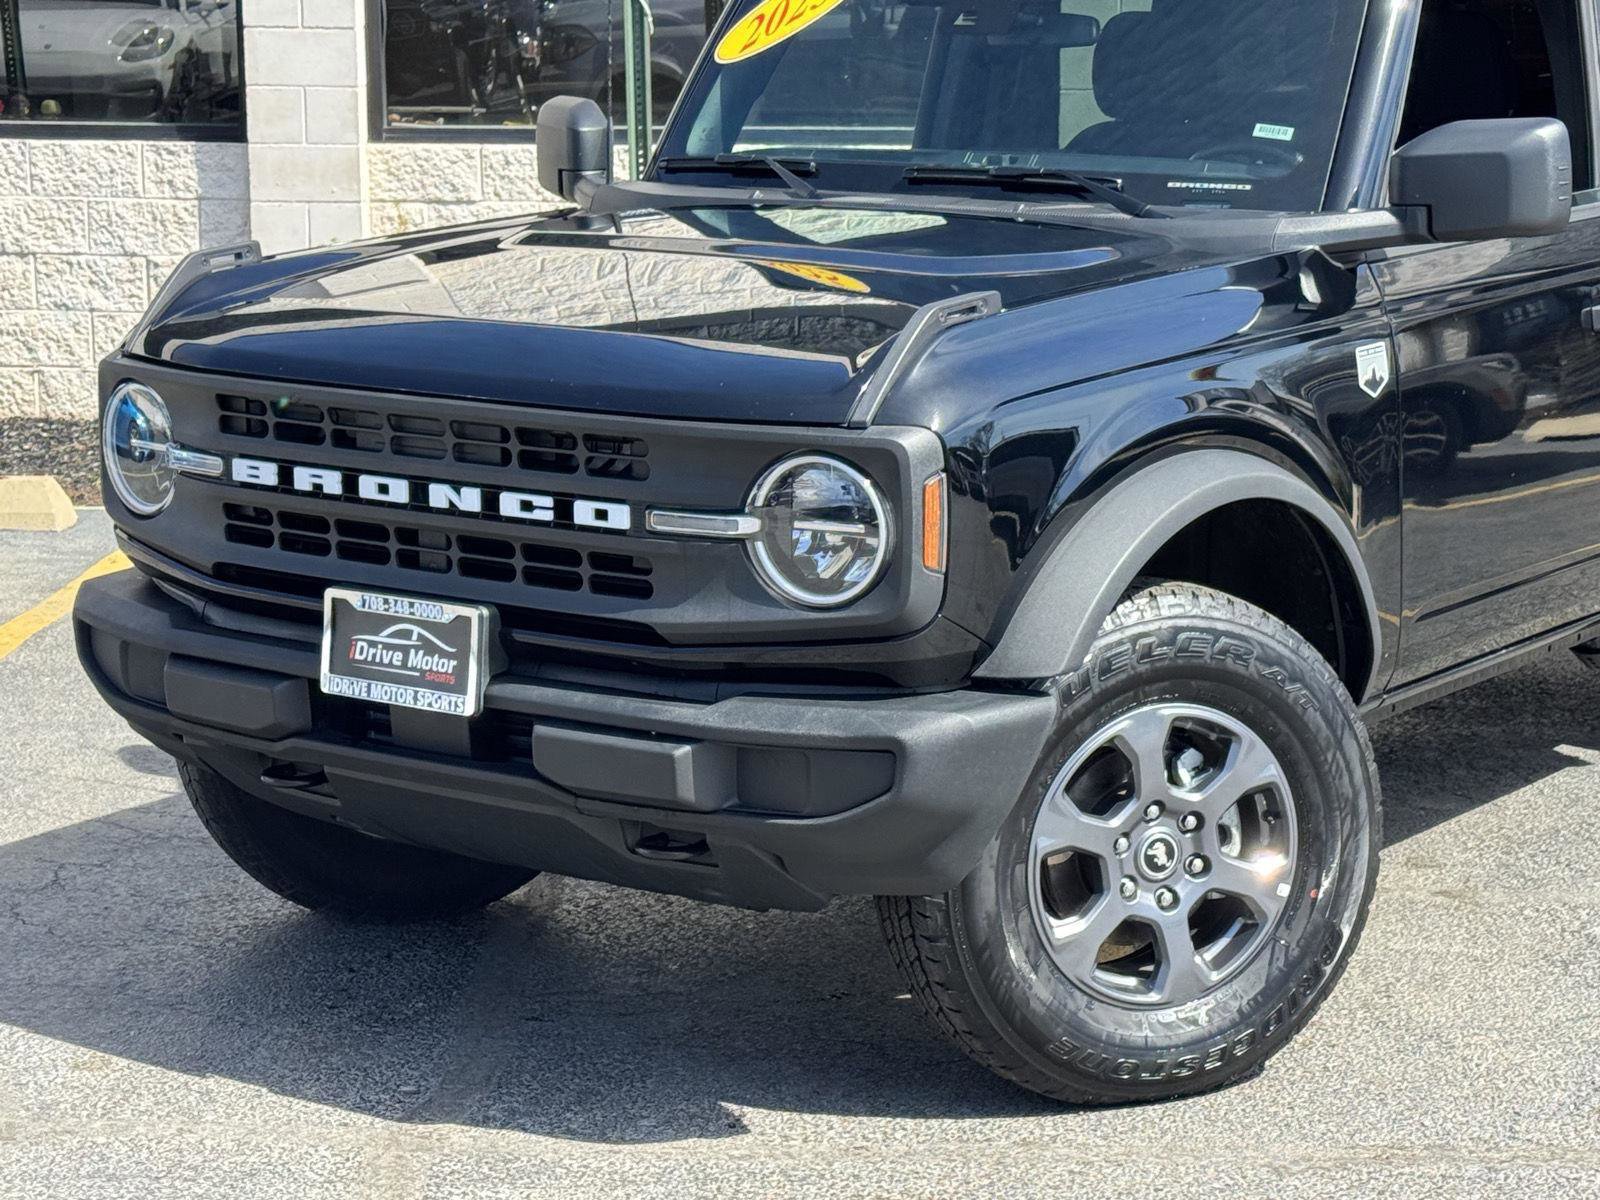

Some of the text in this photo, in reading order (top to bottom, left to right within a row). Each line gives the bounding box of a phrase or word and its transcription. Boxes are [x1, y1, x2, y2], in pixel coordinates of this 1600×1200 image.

[231, 457, 632, 530] BRONCO
[363, 595, 443, 620] 708-348-0000
[349, 641, 458, 674] iDrive Motor
[1058, 631, 1257, 709] UELER
[424, 671, 456, 685] SPORTS
[370, 684, 414, 706] MOTOR
[416, 692, 465, 713] SPORTS
